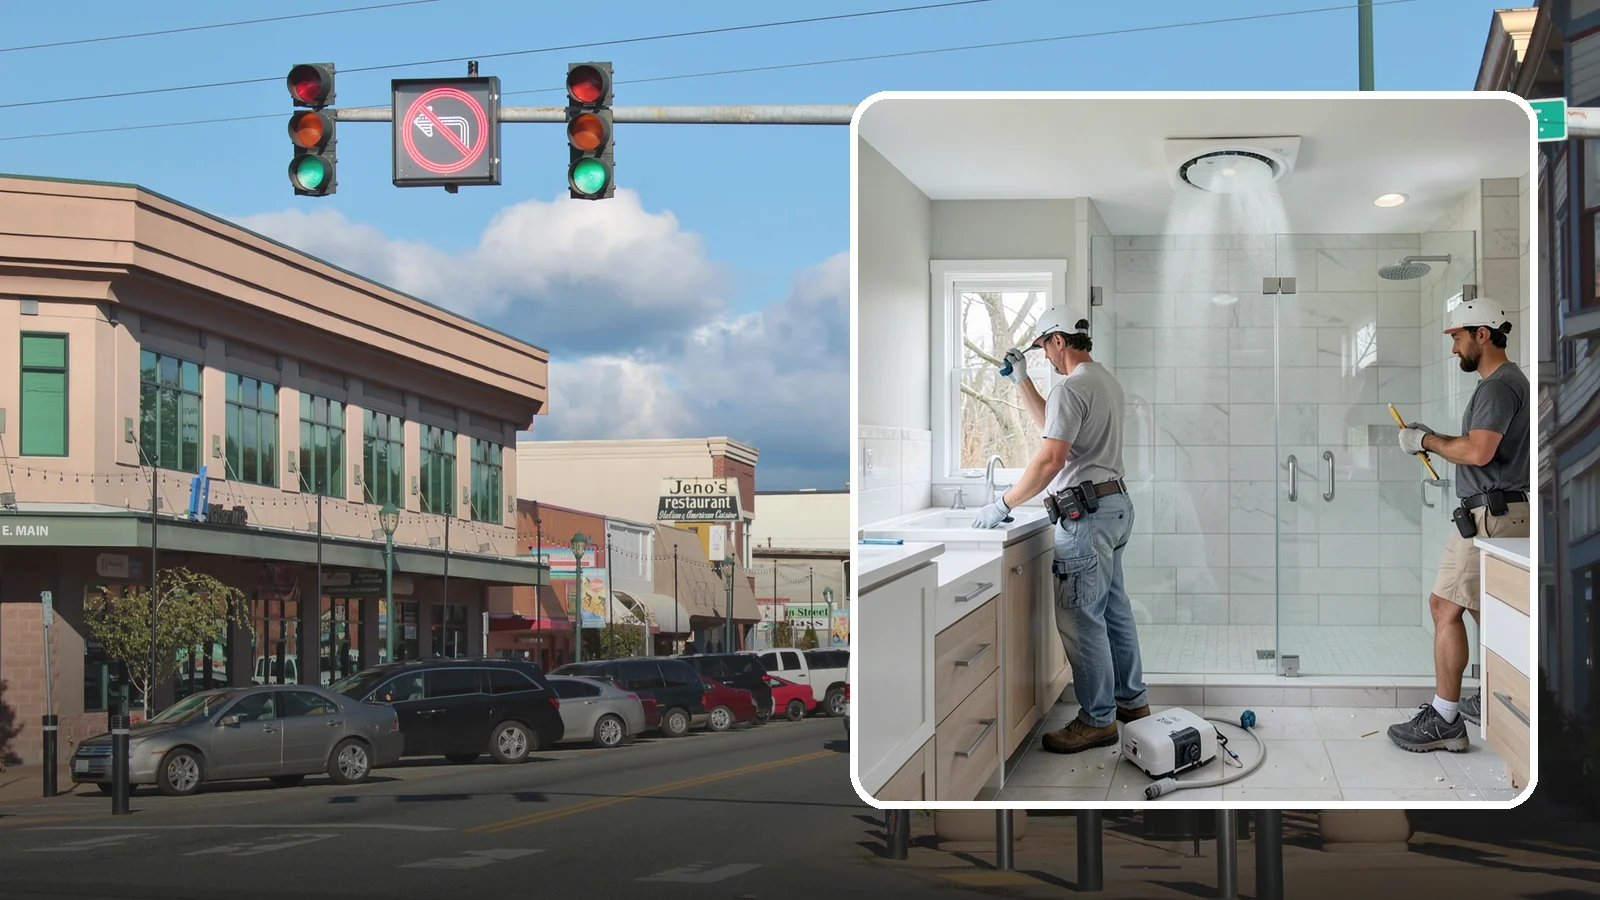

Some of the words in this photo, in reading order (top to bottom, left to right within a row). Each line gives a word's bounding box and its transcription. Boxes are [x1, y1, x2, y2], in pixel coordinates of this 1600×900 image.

[669, 480, 728, 495] Jeno's
[665, 496, 731, 509] restaurant
[658, 510, 682, 519] Italian
[686, 509, 714, 519] American
[714, 509, 738, 519] Cuisine
[2, 525, 13, 536] E.
[15, 525, 49, 536] MAIN
[797, 607, 828, 617] Street
[791, 619, 823, 627] lass
